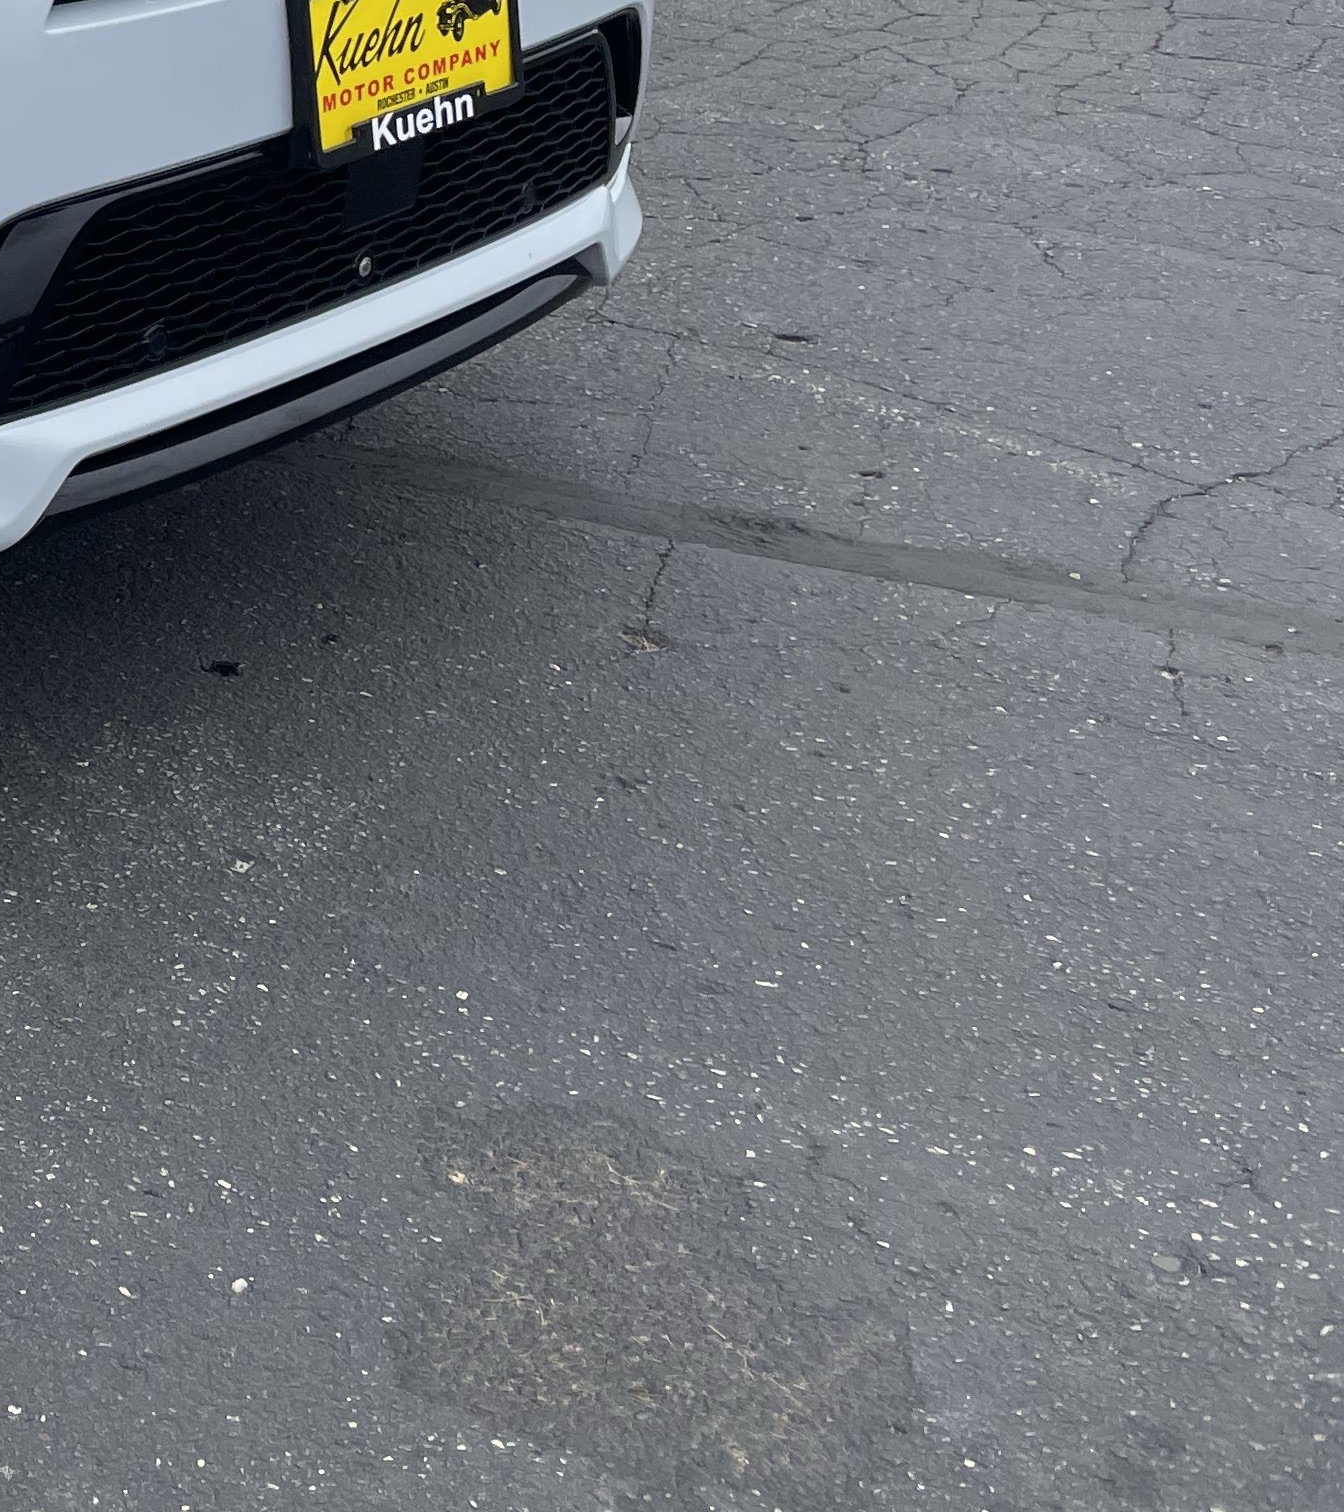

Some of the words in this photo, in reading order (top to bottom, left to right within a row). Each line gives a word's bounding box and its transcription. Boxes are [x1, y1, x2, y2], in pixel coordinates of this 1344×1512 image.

[323, 75, 394, 113] MOTOR
[403, 39, 501, 86] COMPANY
[377, 87, 416, 112] ROCHESTER
[425, 77, 449, 96] AUSTIN
[372, 93, 474, 151] Kuehn
